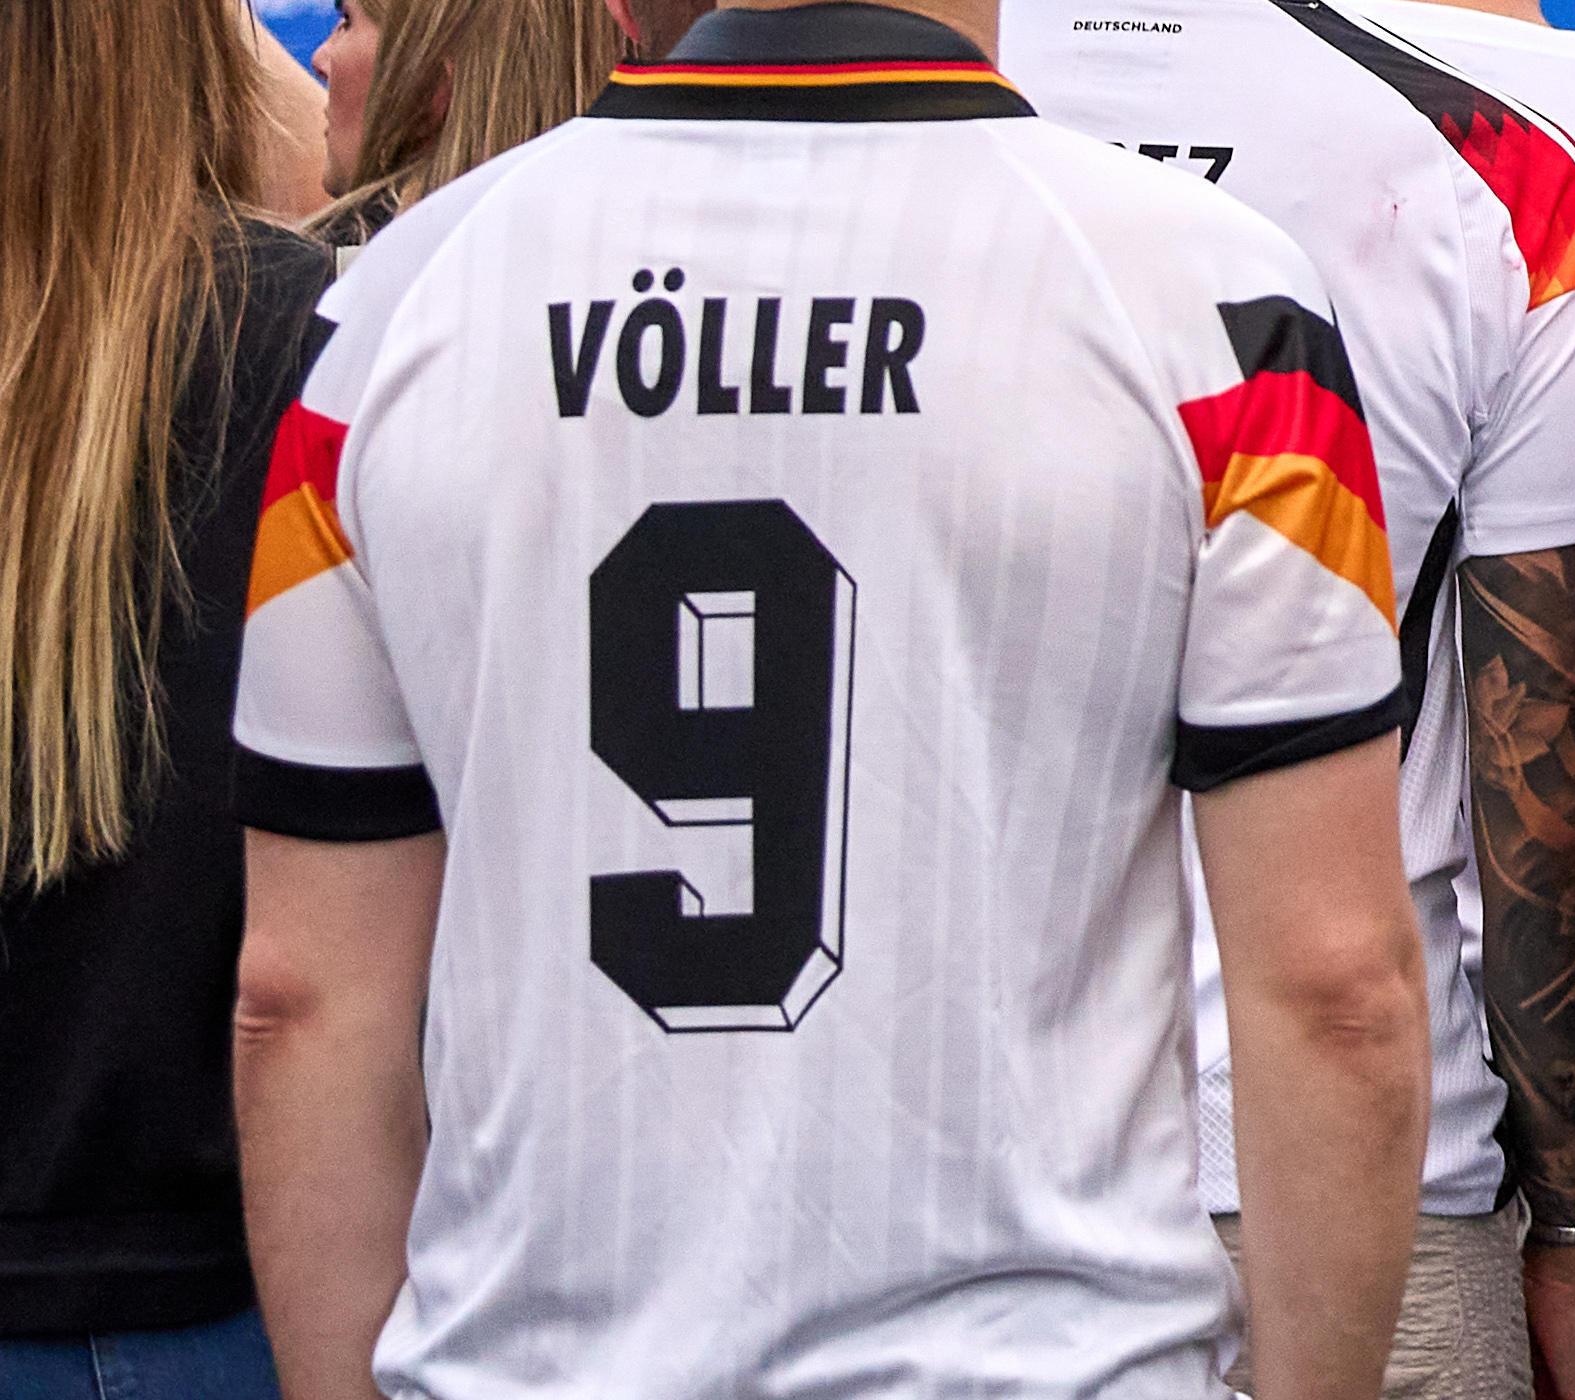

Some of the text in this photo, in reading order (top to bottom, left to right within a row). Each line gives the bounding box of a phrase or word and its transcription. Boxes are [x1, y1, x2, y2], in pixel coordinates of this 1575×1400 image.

[1073, 20, 1183, 34] DEUTSCHLAND
[547, 267, 925, 419] VÖLLER
[588, 498, 858, 1035] 9
